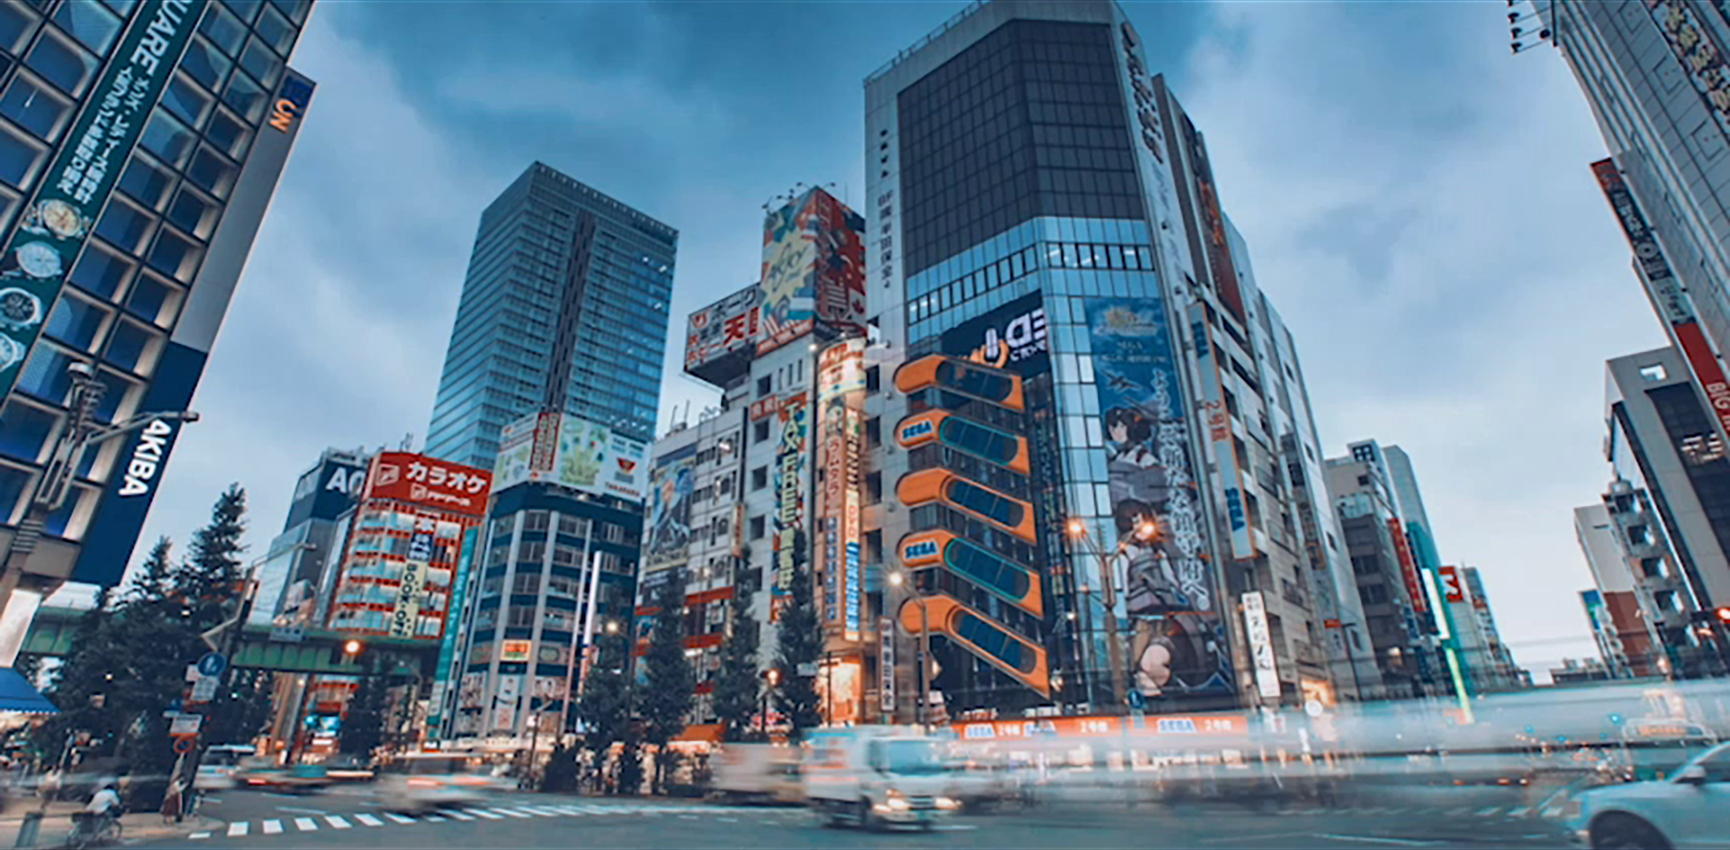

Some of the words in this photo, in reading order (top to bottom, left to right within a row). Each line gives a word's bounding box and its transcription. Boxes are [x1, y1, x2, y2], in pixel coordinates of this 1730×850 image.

[130, 0, 194, 77] UARE
[784, 401, 799, 453] TAX
[902, 420, 932, 440] SEGA
[118, 418, 172, 497] AKIBA
[406, 461, 487, 494] カラオケ
[783, 454, 798, 525] FREE
[906, 541, 937, 559] SEGA
[1158, 718, 1196, 733] SEGA
